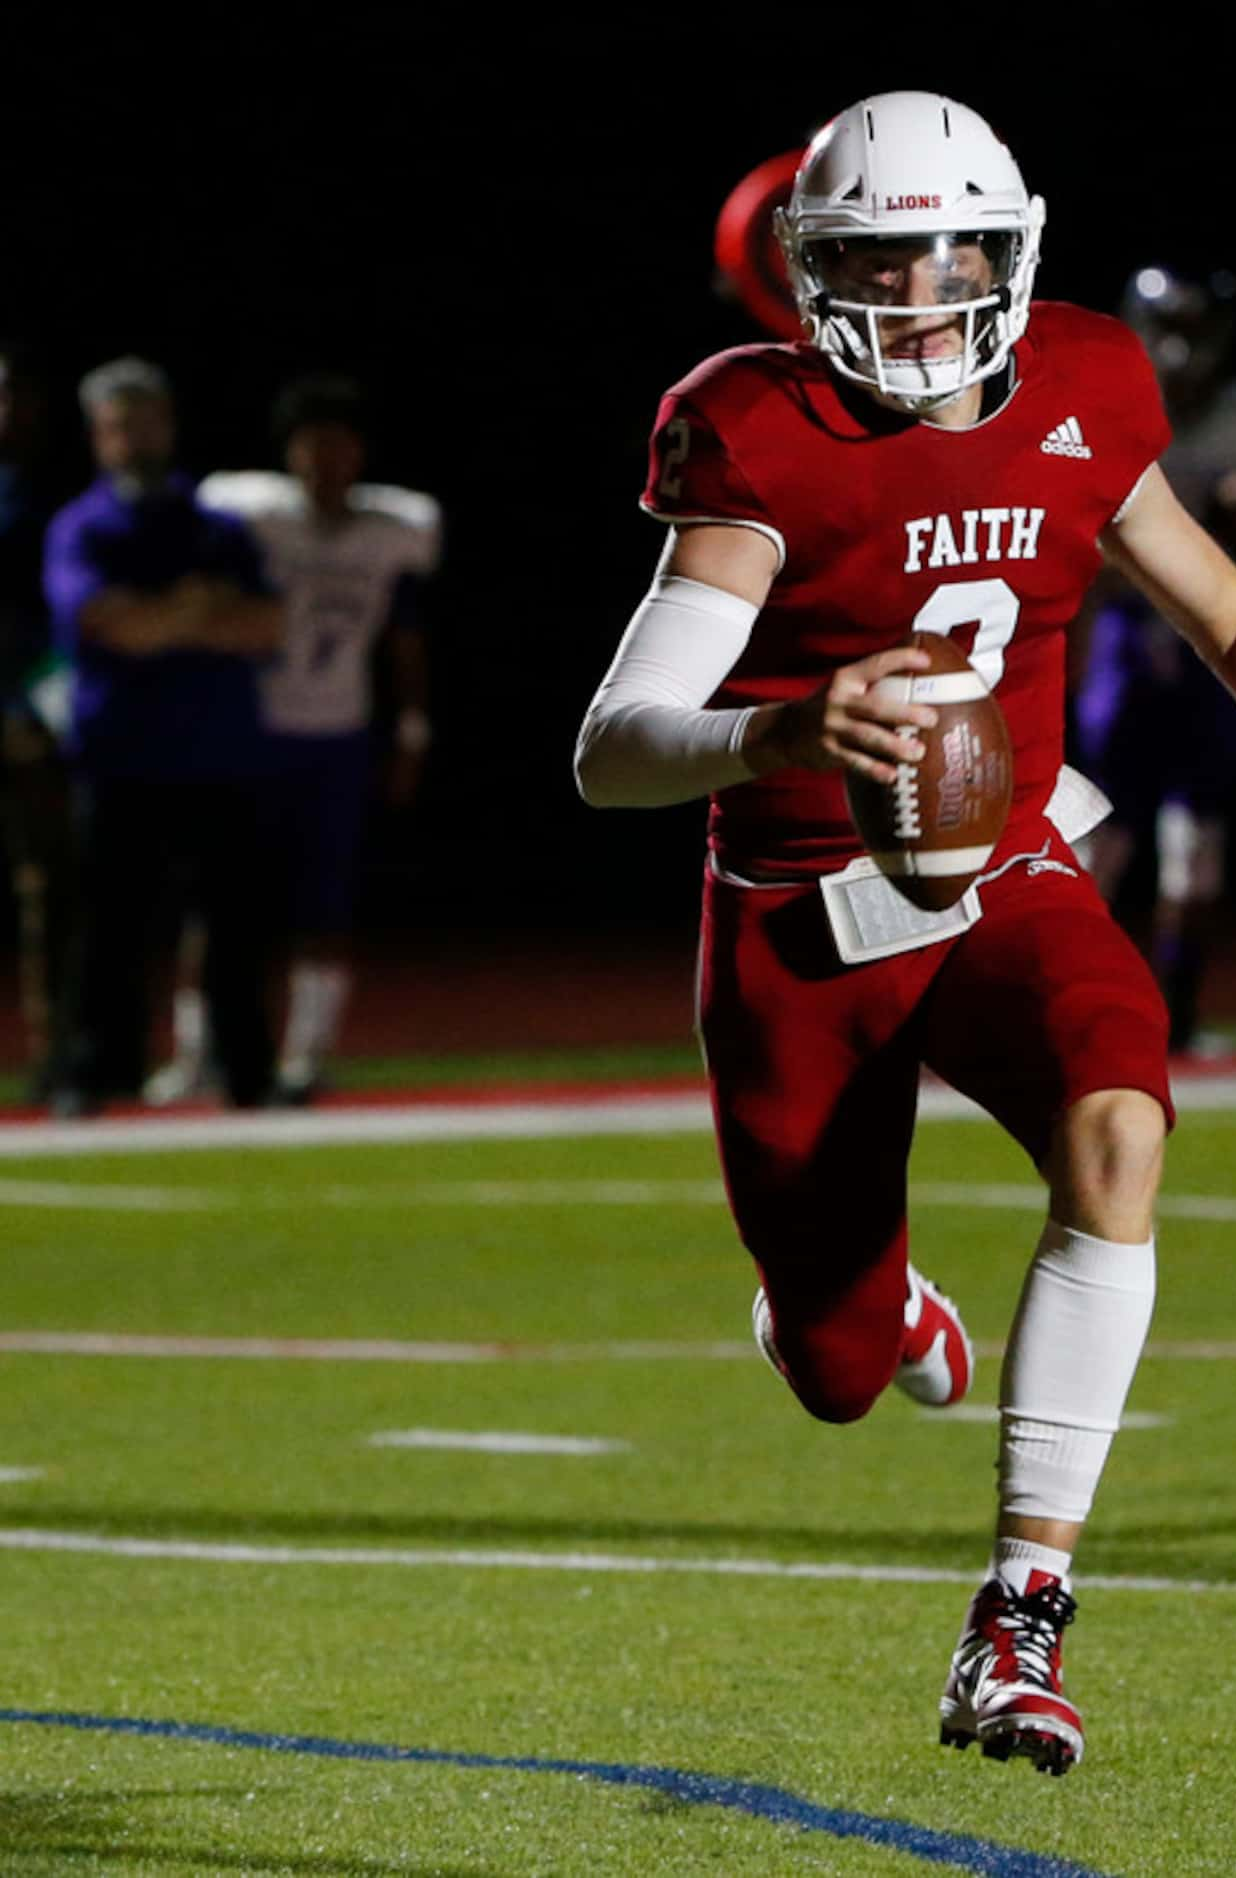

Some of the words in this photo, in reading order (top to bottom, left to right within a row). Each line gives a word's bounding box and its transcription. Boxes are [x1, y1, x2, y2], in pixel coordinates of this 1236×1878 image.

[885, 194, 942, 211] LIONS
[660, 417, 690, 498] 2
[1040, 440, 1092, 460] adidas
[903, 507, 1046, 573] FAITH
